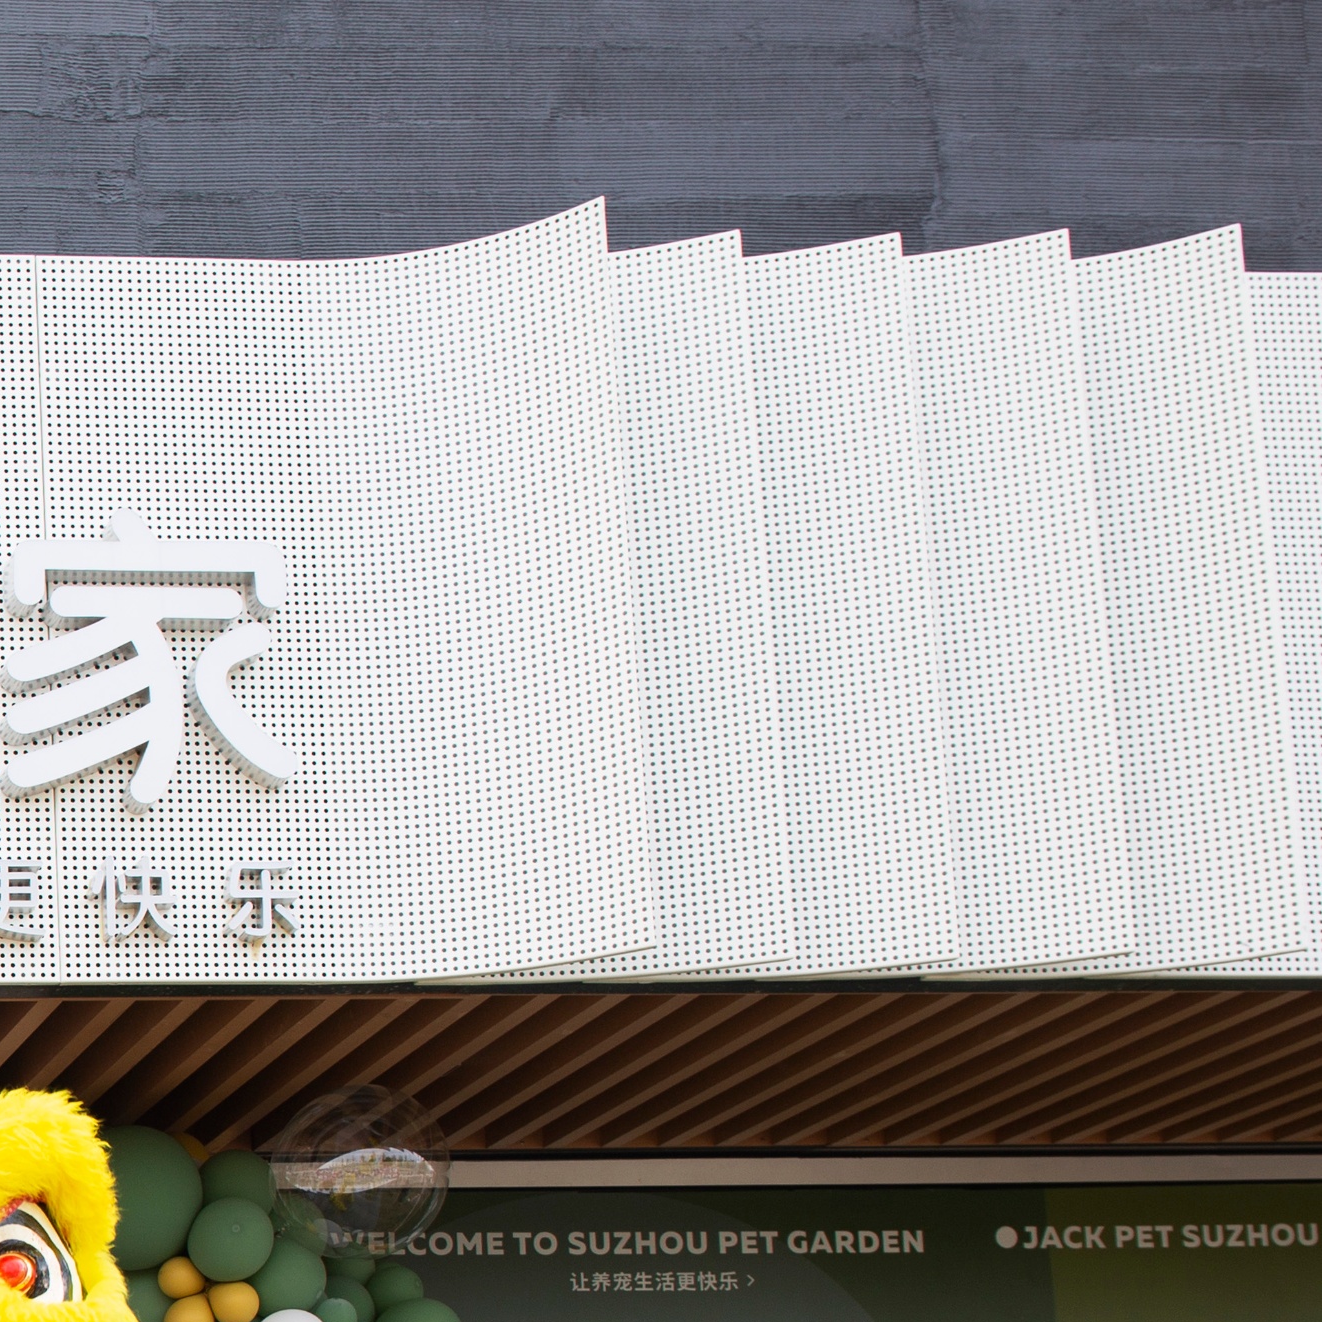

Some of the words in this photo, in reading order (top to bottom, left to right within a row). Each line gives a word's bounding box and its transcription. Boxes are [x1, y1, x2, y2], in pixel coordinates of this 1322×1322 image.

[512, 1231, 559, 1256] TO
[567, 1229, 709, 1256] SUZHOU
[719, 1229, 780, 1255] PET
[787, 1228, 925, 1255] GARDEN
[1023, 1225, 1107, 1250] JACK
[1114, 1225, 1173, 1249] PET
[1182, 1223, 1319, 1248] SUZHOU
[569, 1271, 739, 1292] 让养宠生活更快乐
